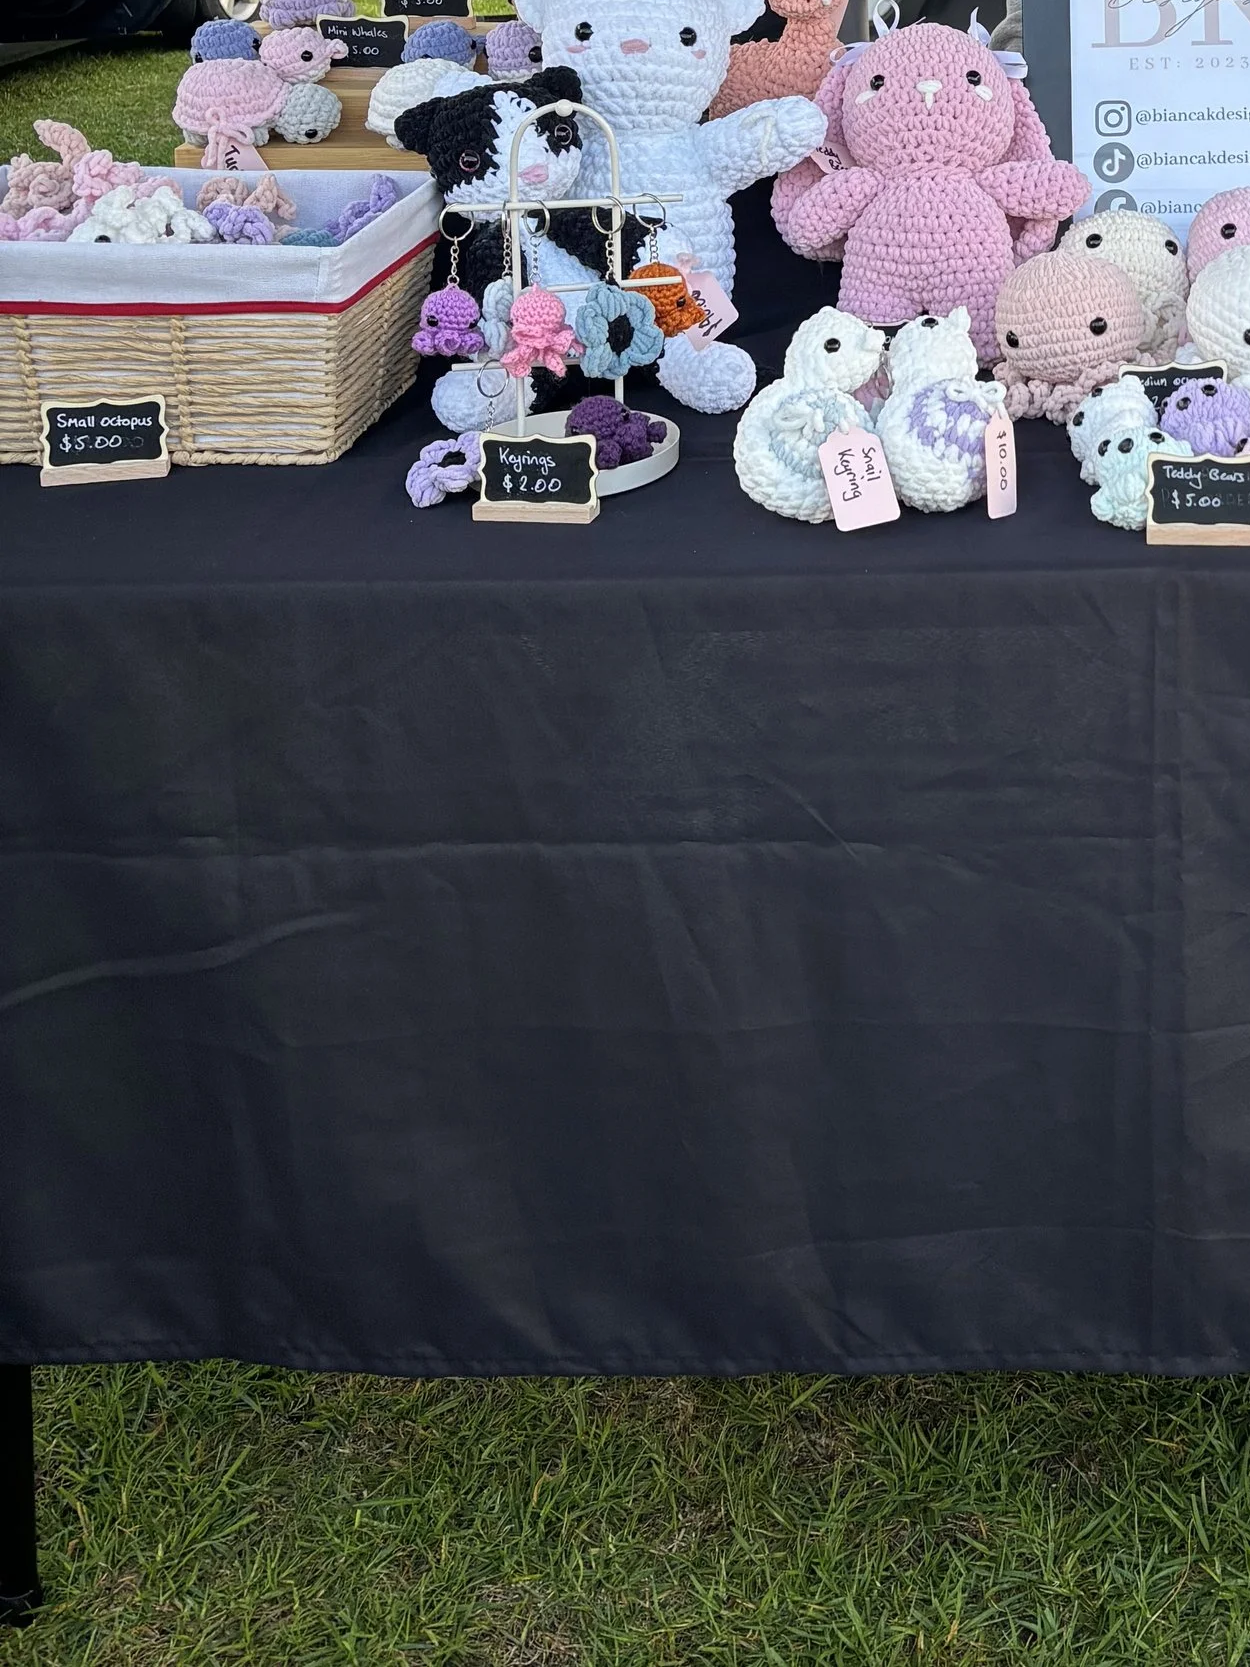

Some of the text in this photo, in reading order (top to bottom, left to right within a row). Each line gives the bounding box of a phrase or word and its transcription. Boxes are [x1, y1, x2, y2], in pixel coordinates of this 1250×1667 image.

[328, 26, 388, 38] Mini Whales
[1129, 56, 1250, 70] EST: 2023
[224, 145, 244, 171] Tur
[1140, 200, 1202, 214] @bianc
[57, 413, 152, 430] Small octopus
[60, 434, 122, 452] $5.00
[499, 446, 556, 475] Keyrings
[862, 447, 882, 481] Snail
[997, 430, 1007, 490] $10.00
[834, 448, 864, 501] Keyring
[1163, 465, 1245, 489] Teddy Bears
